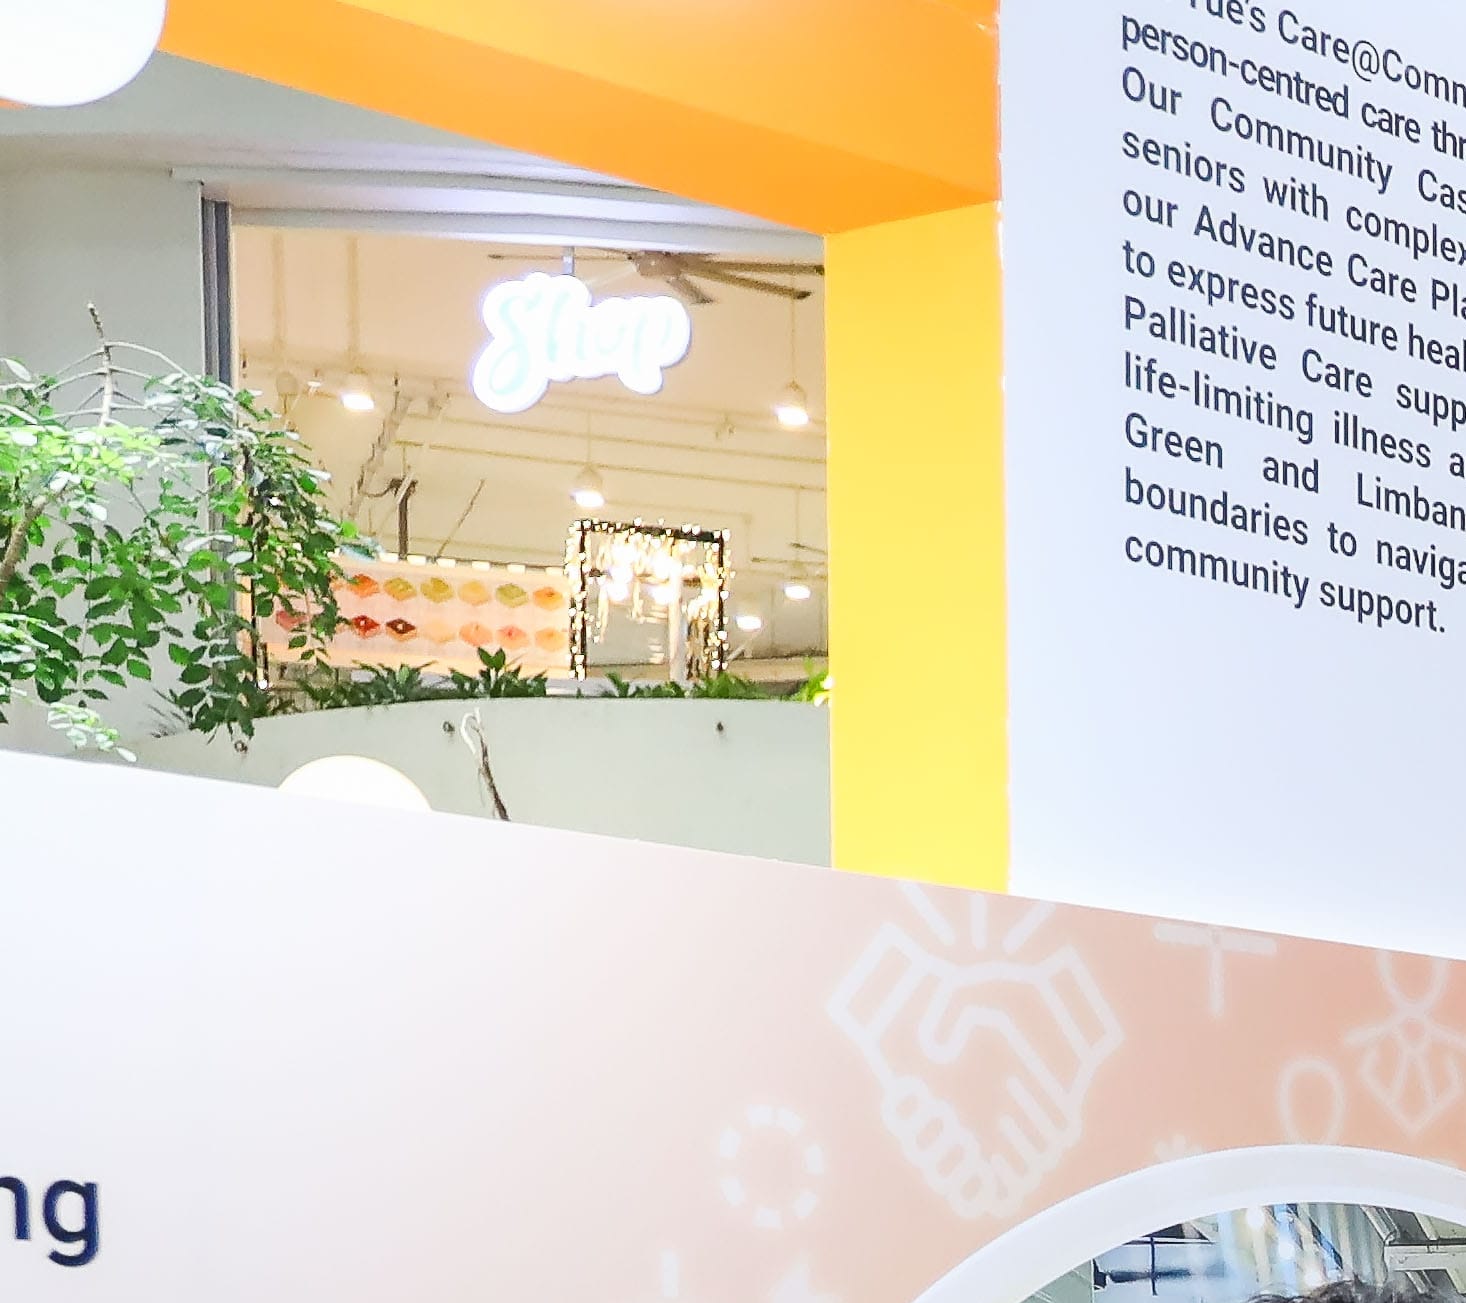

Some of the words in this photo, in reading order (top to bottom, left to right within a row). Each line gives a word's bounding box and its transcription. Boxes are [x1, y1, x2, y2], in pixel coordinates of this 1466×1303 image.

[1122, 15, 1349, 119] person-centred
[1361, 102, 1421, 144] care
[1122, 66, 1183, 115] Our
[1210, 97, 1393, 195] Community
[1122, 131, 1245, 194] seniors
[1263, 176, 1329, 222] with
